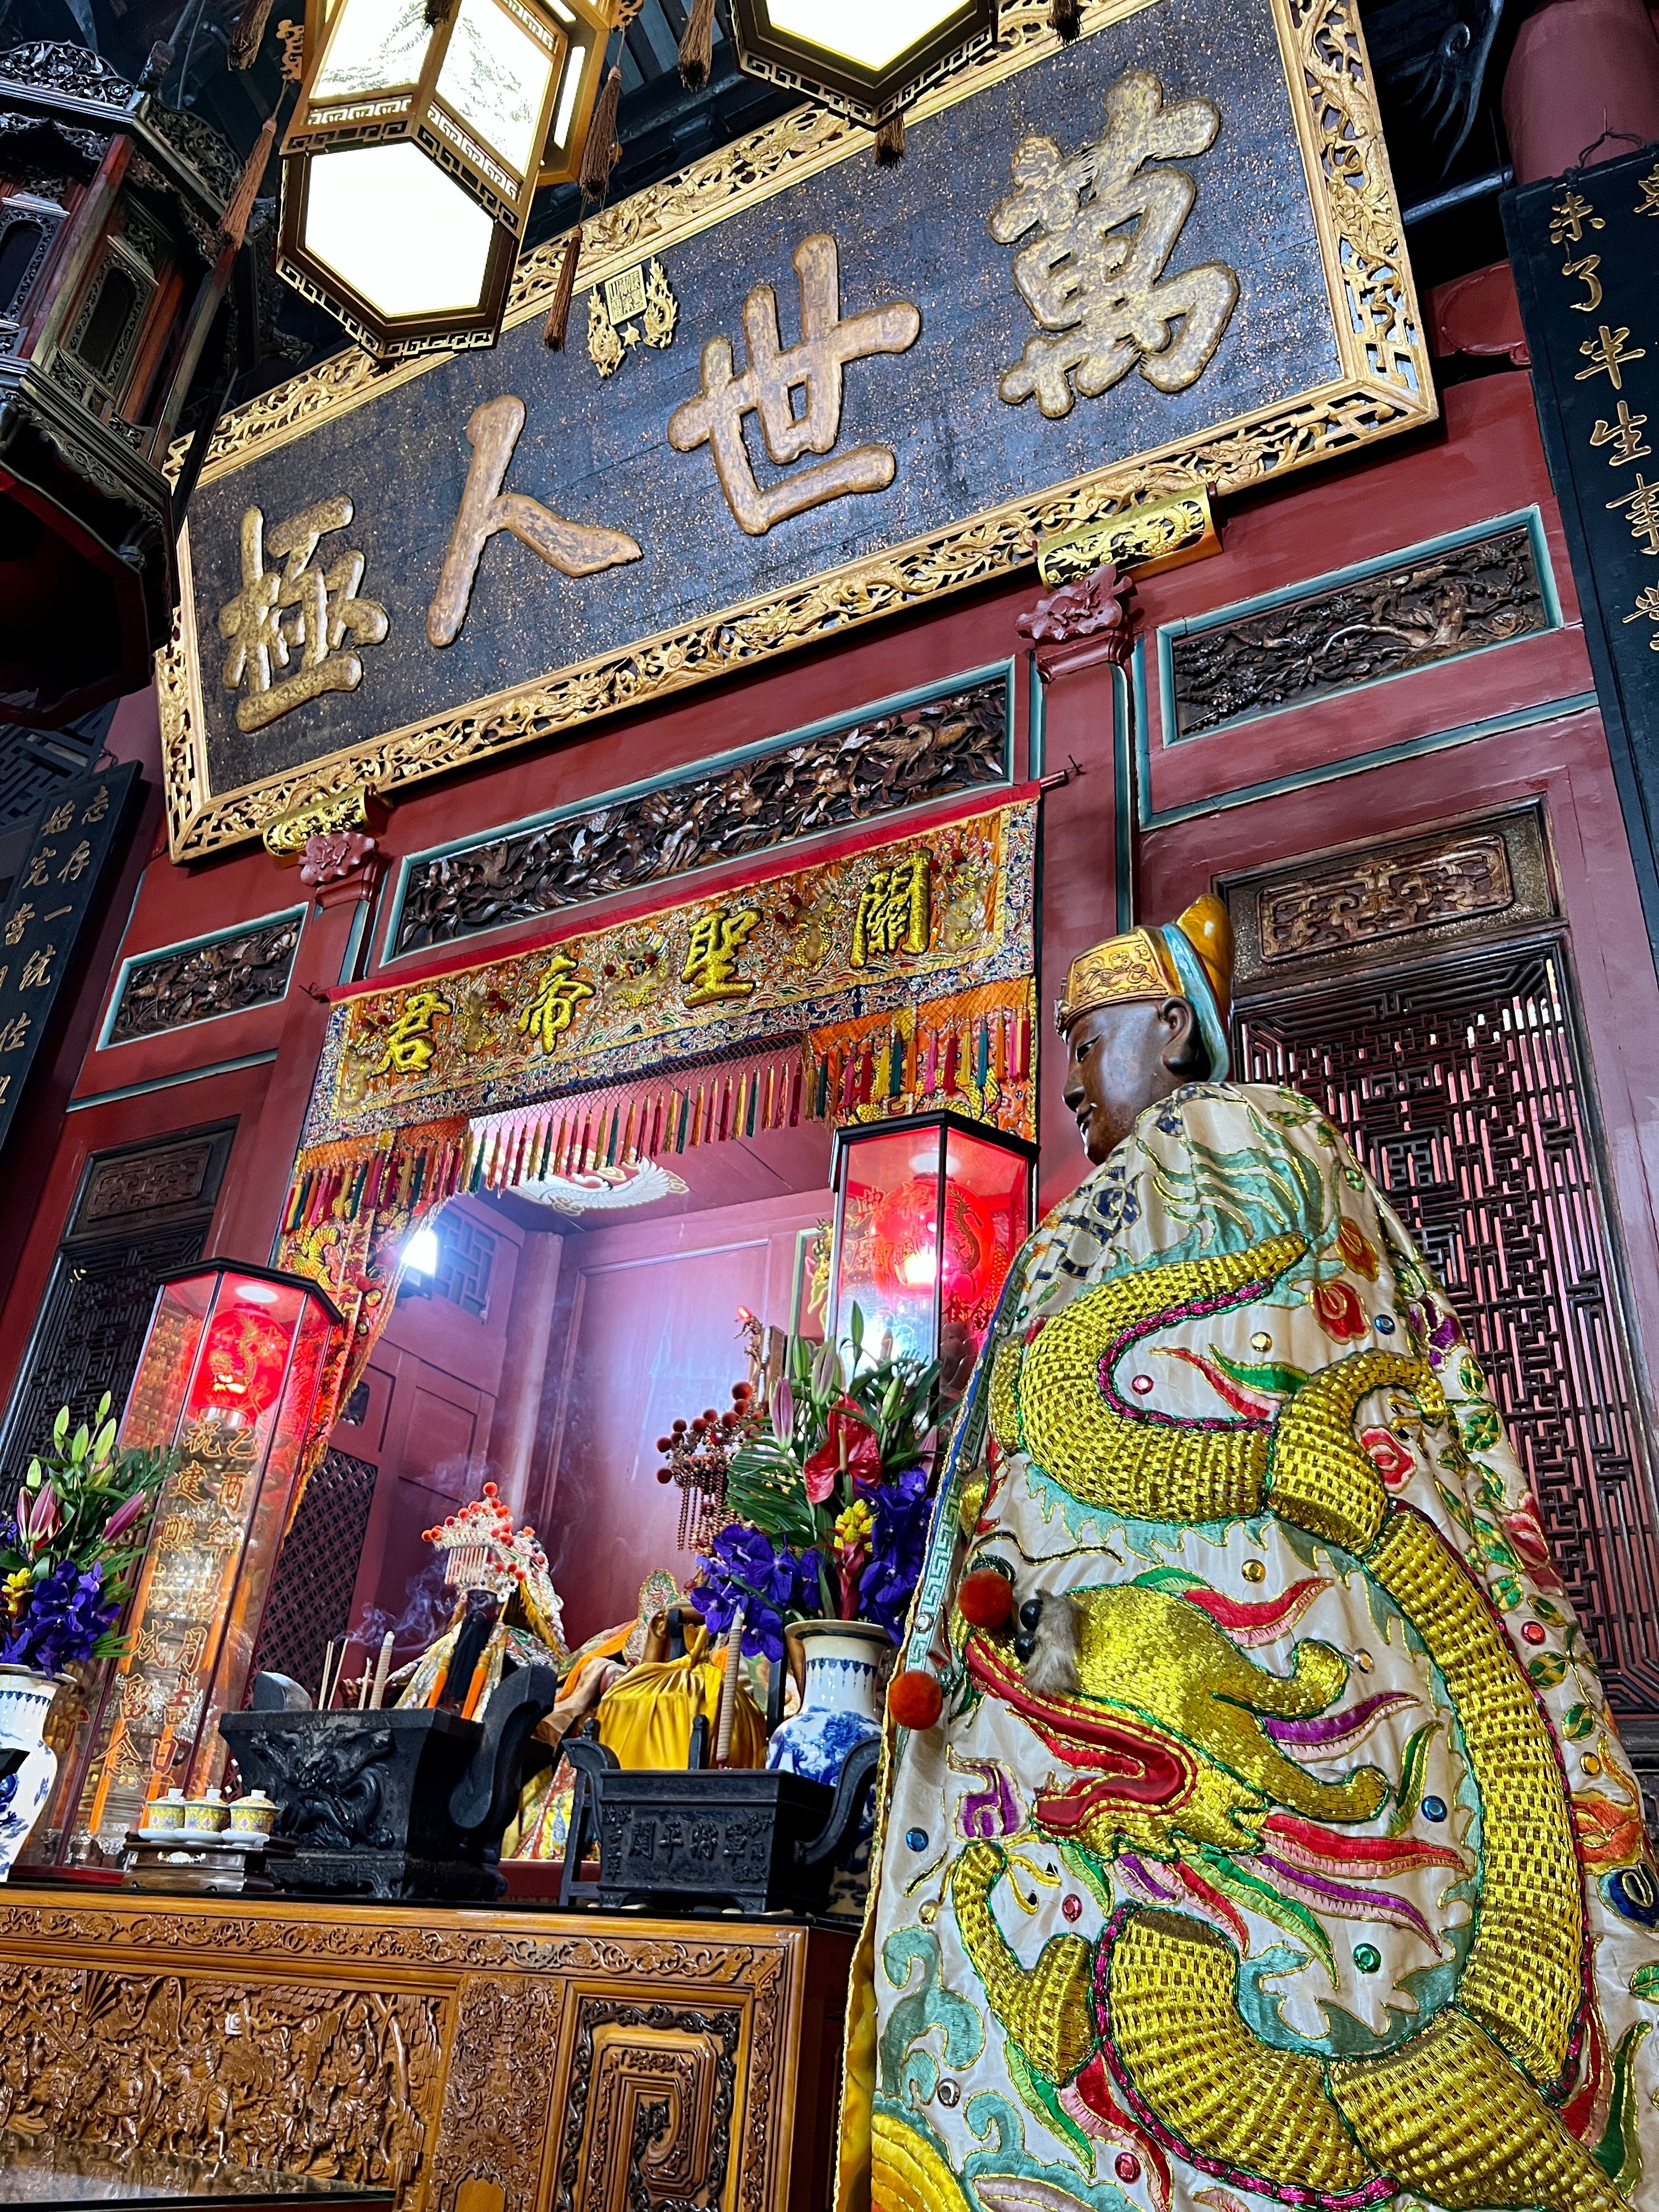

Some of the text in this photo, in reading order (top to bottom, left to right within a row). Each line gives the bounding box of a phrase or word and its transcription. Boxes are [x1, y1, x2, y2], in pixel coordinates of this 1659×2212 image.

[218, 69, 1241, 734] 萬世人極
[0, 786, 109, 1104] 志存一統佐
[371, 847, 932, 1076] 關聖帝君
